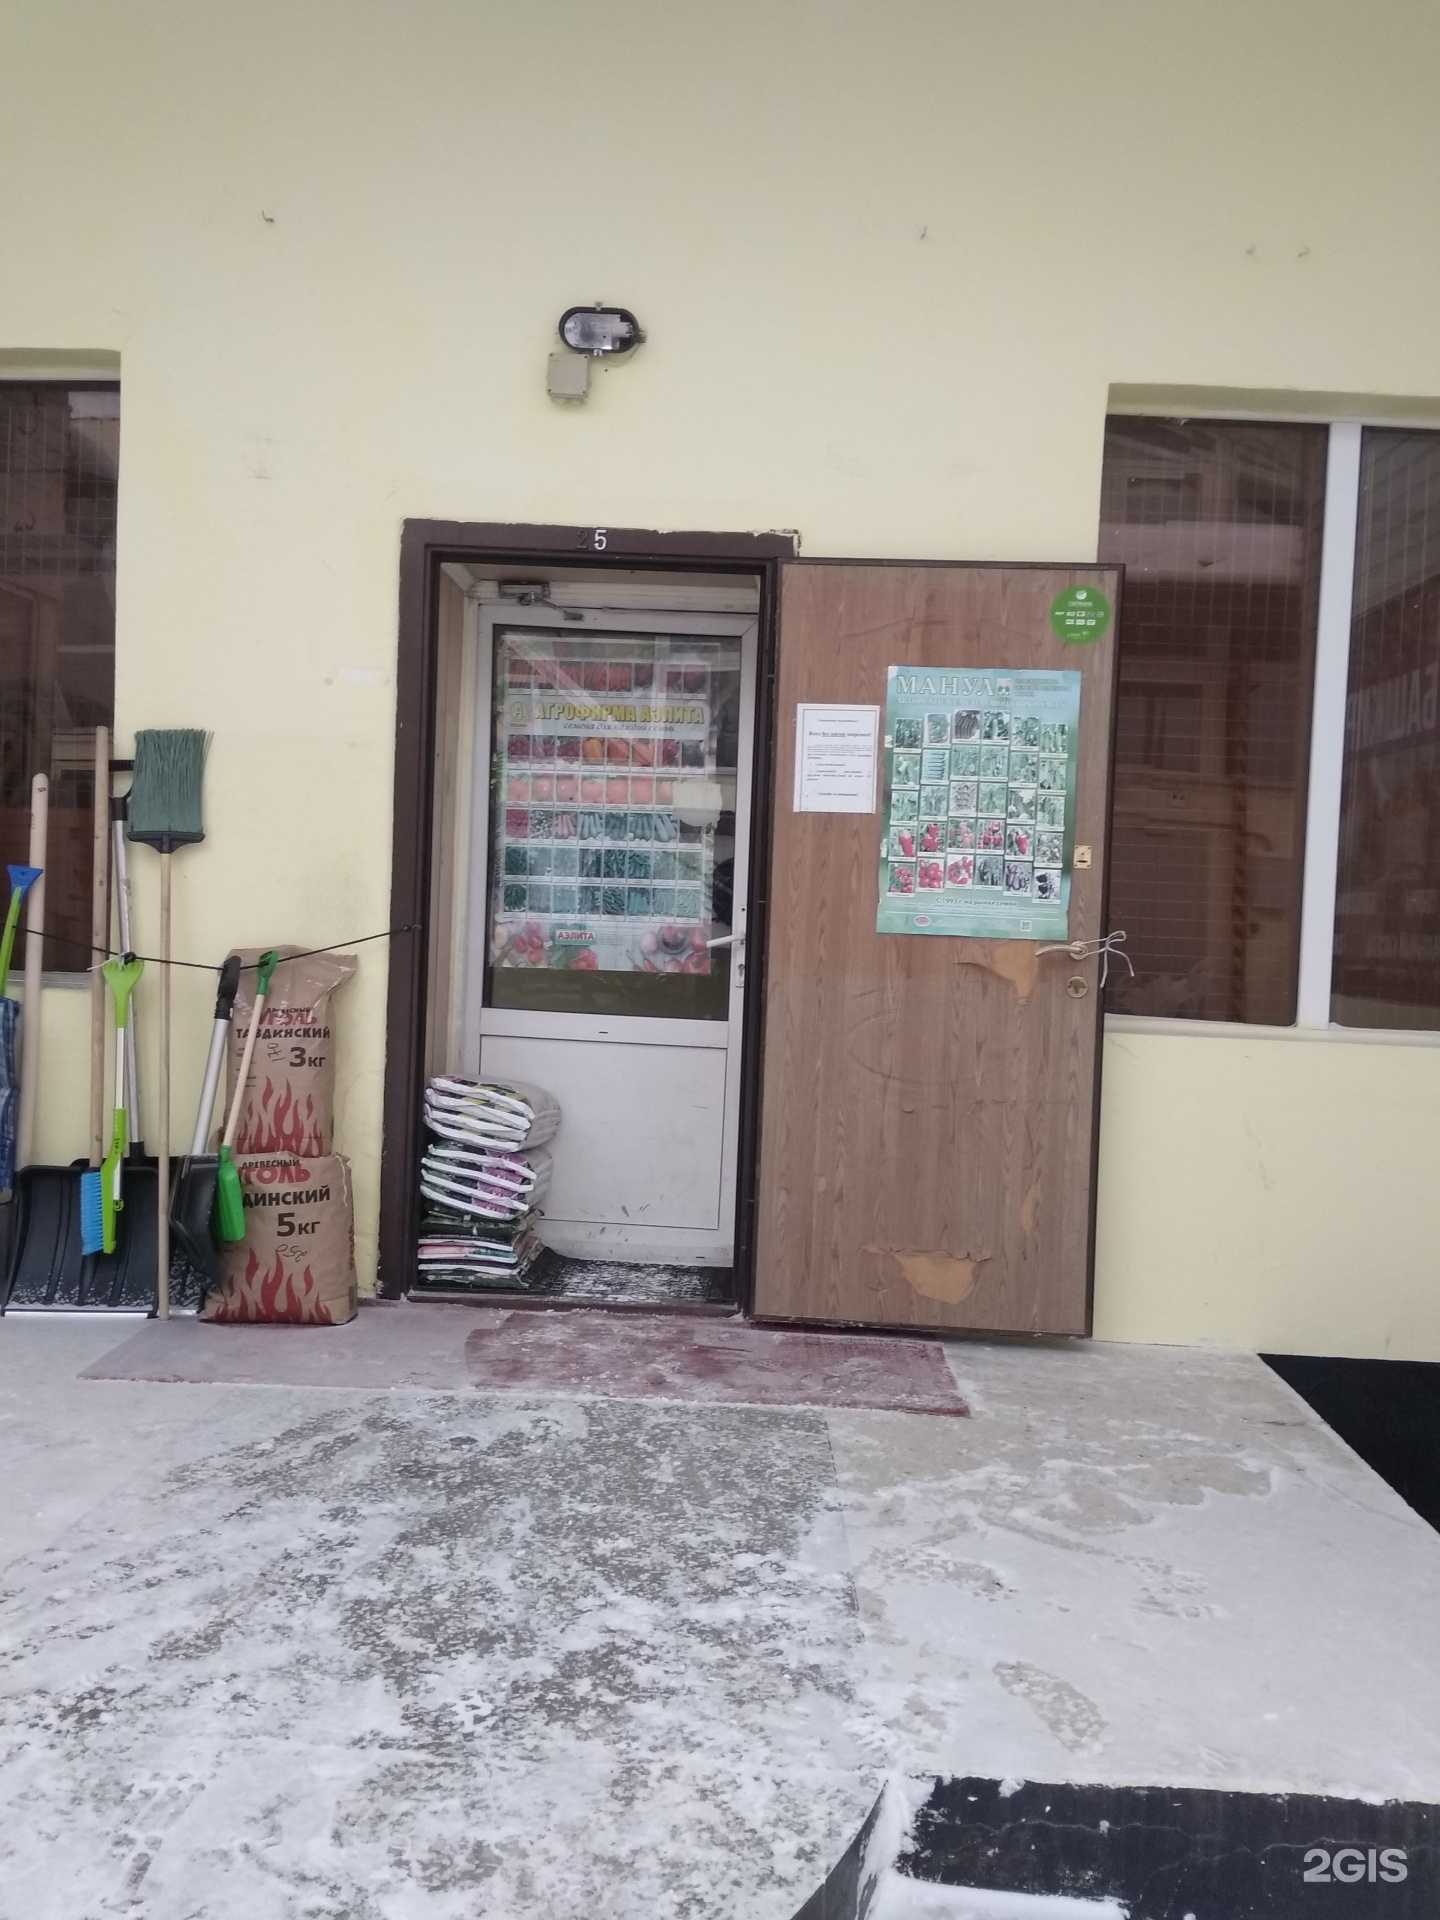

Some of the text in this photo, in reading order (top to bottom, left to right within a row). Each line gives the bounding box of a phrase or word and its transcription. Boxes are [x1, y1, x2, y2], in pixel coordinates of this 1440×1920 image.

[897, 675, 995, 697] МАНУЛ
[535, 703, 637, 721] АГРОФИРМА
[558, 931, 594, 941] АЭЛИТА
[240, 1160, 300, 1169] ДРЕВЕСНЫЙ
[238, 1167, 311, 1185] ГОЛЬ
